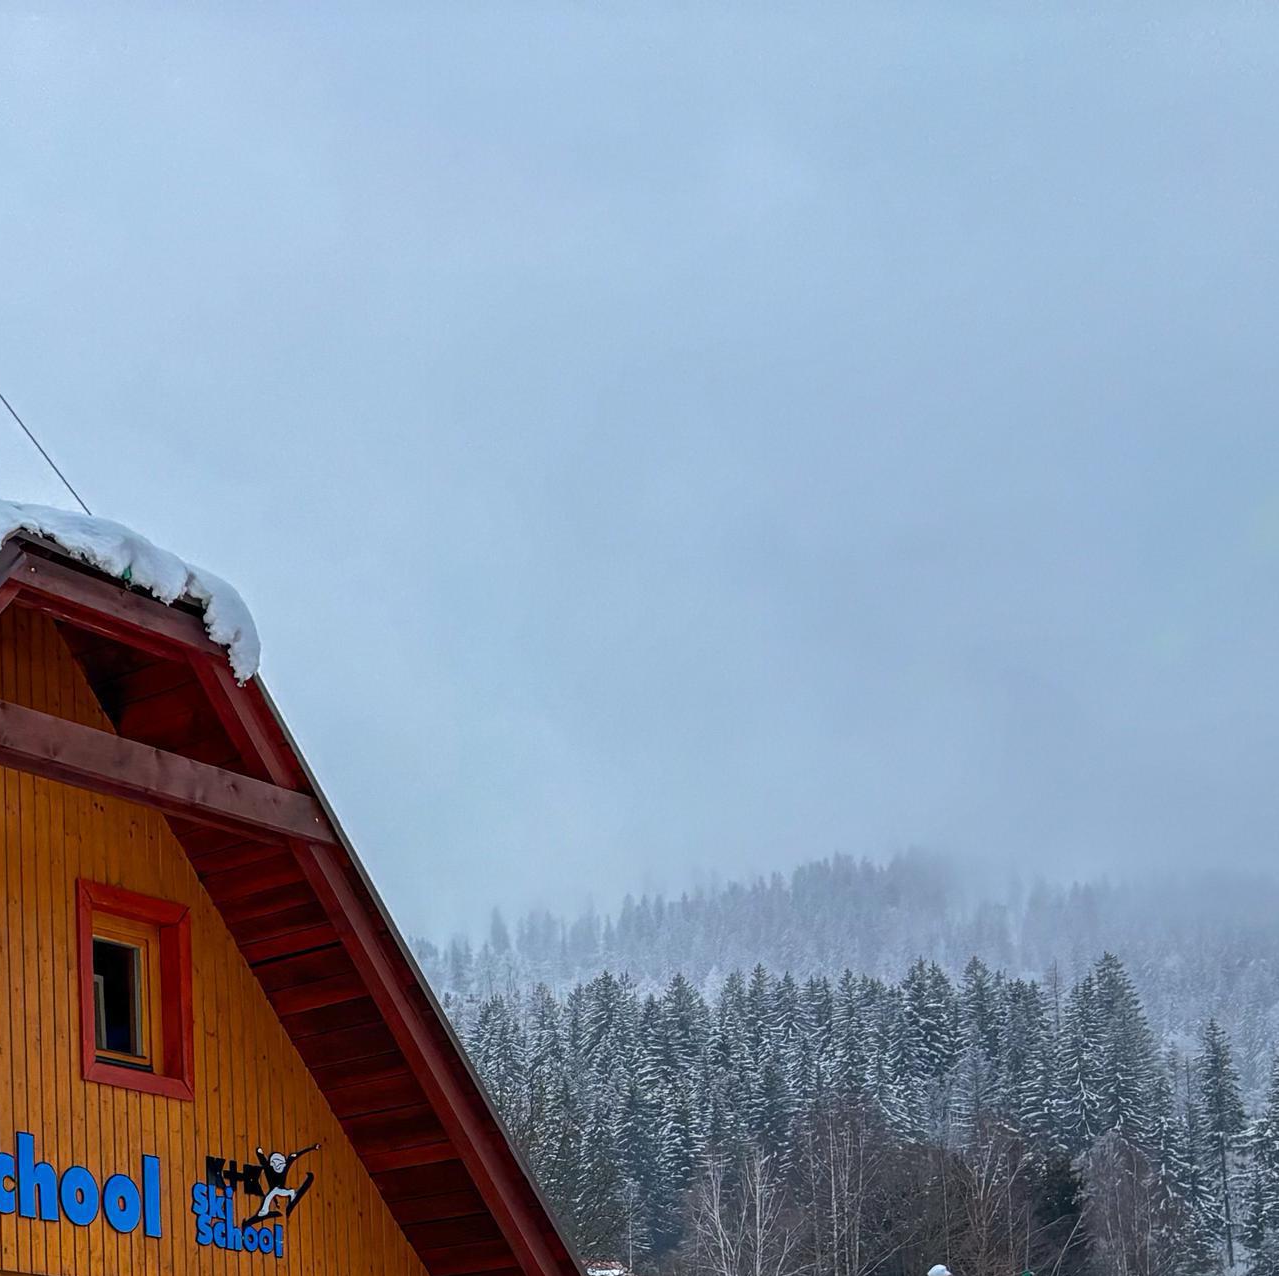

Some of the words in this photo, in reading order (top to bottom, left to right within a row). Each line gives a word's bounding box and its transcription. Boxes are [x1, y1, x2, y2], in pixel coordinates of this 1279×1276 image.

[206, 1156, 266, 1196] K+K
[192, 1182, 233, 1219] Ski
[196, 1214, 283, 1258] School
